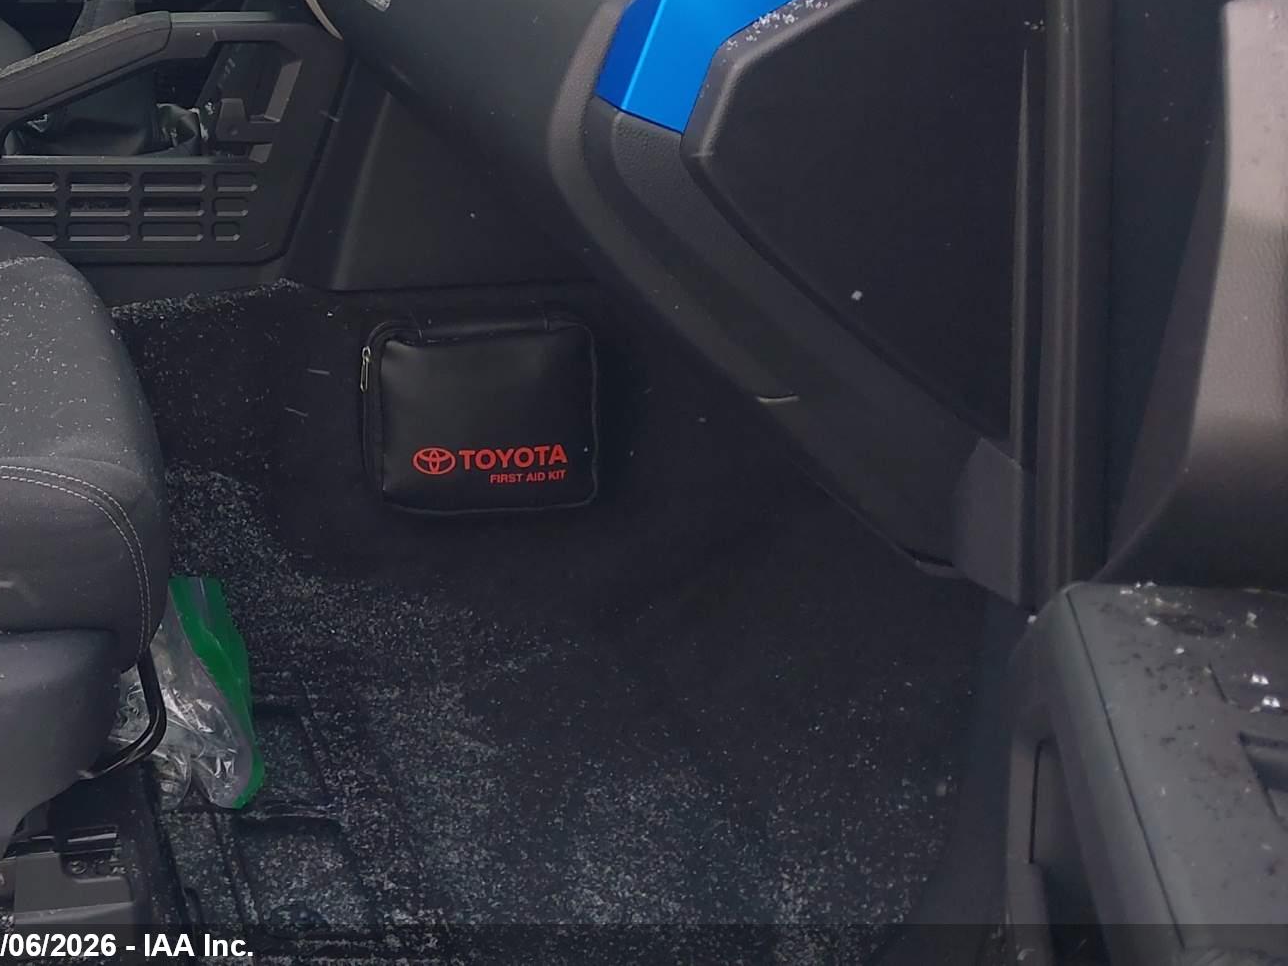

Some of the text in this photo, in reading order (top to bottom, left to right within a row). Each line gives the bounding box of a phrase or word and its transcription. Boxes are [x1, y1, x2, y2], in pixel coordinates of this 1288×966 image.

[459, 444, 568, 470] TOYOTA
[490, 470, 566, 484] FIRST AID KIT
